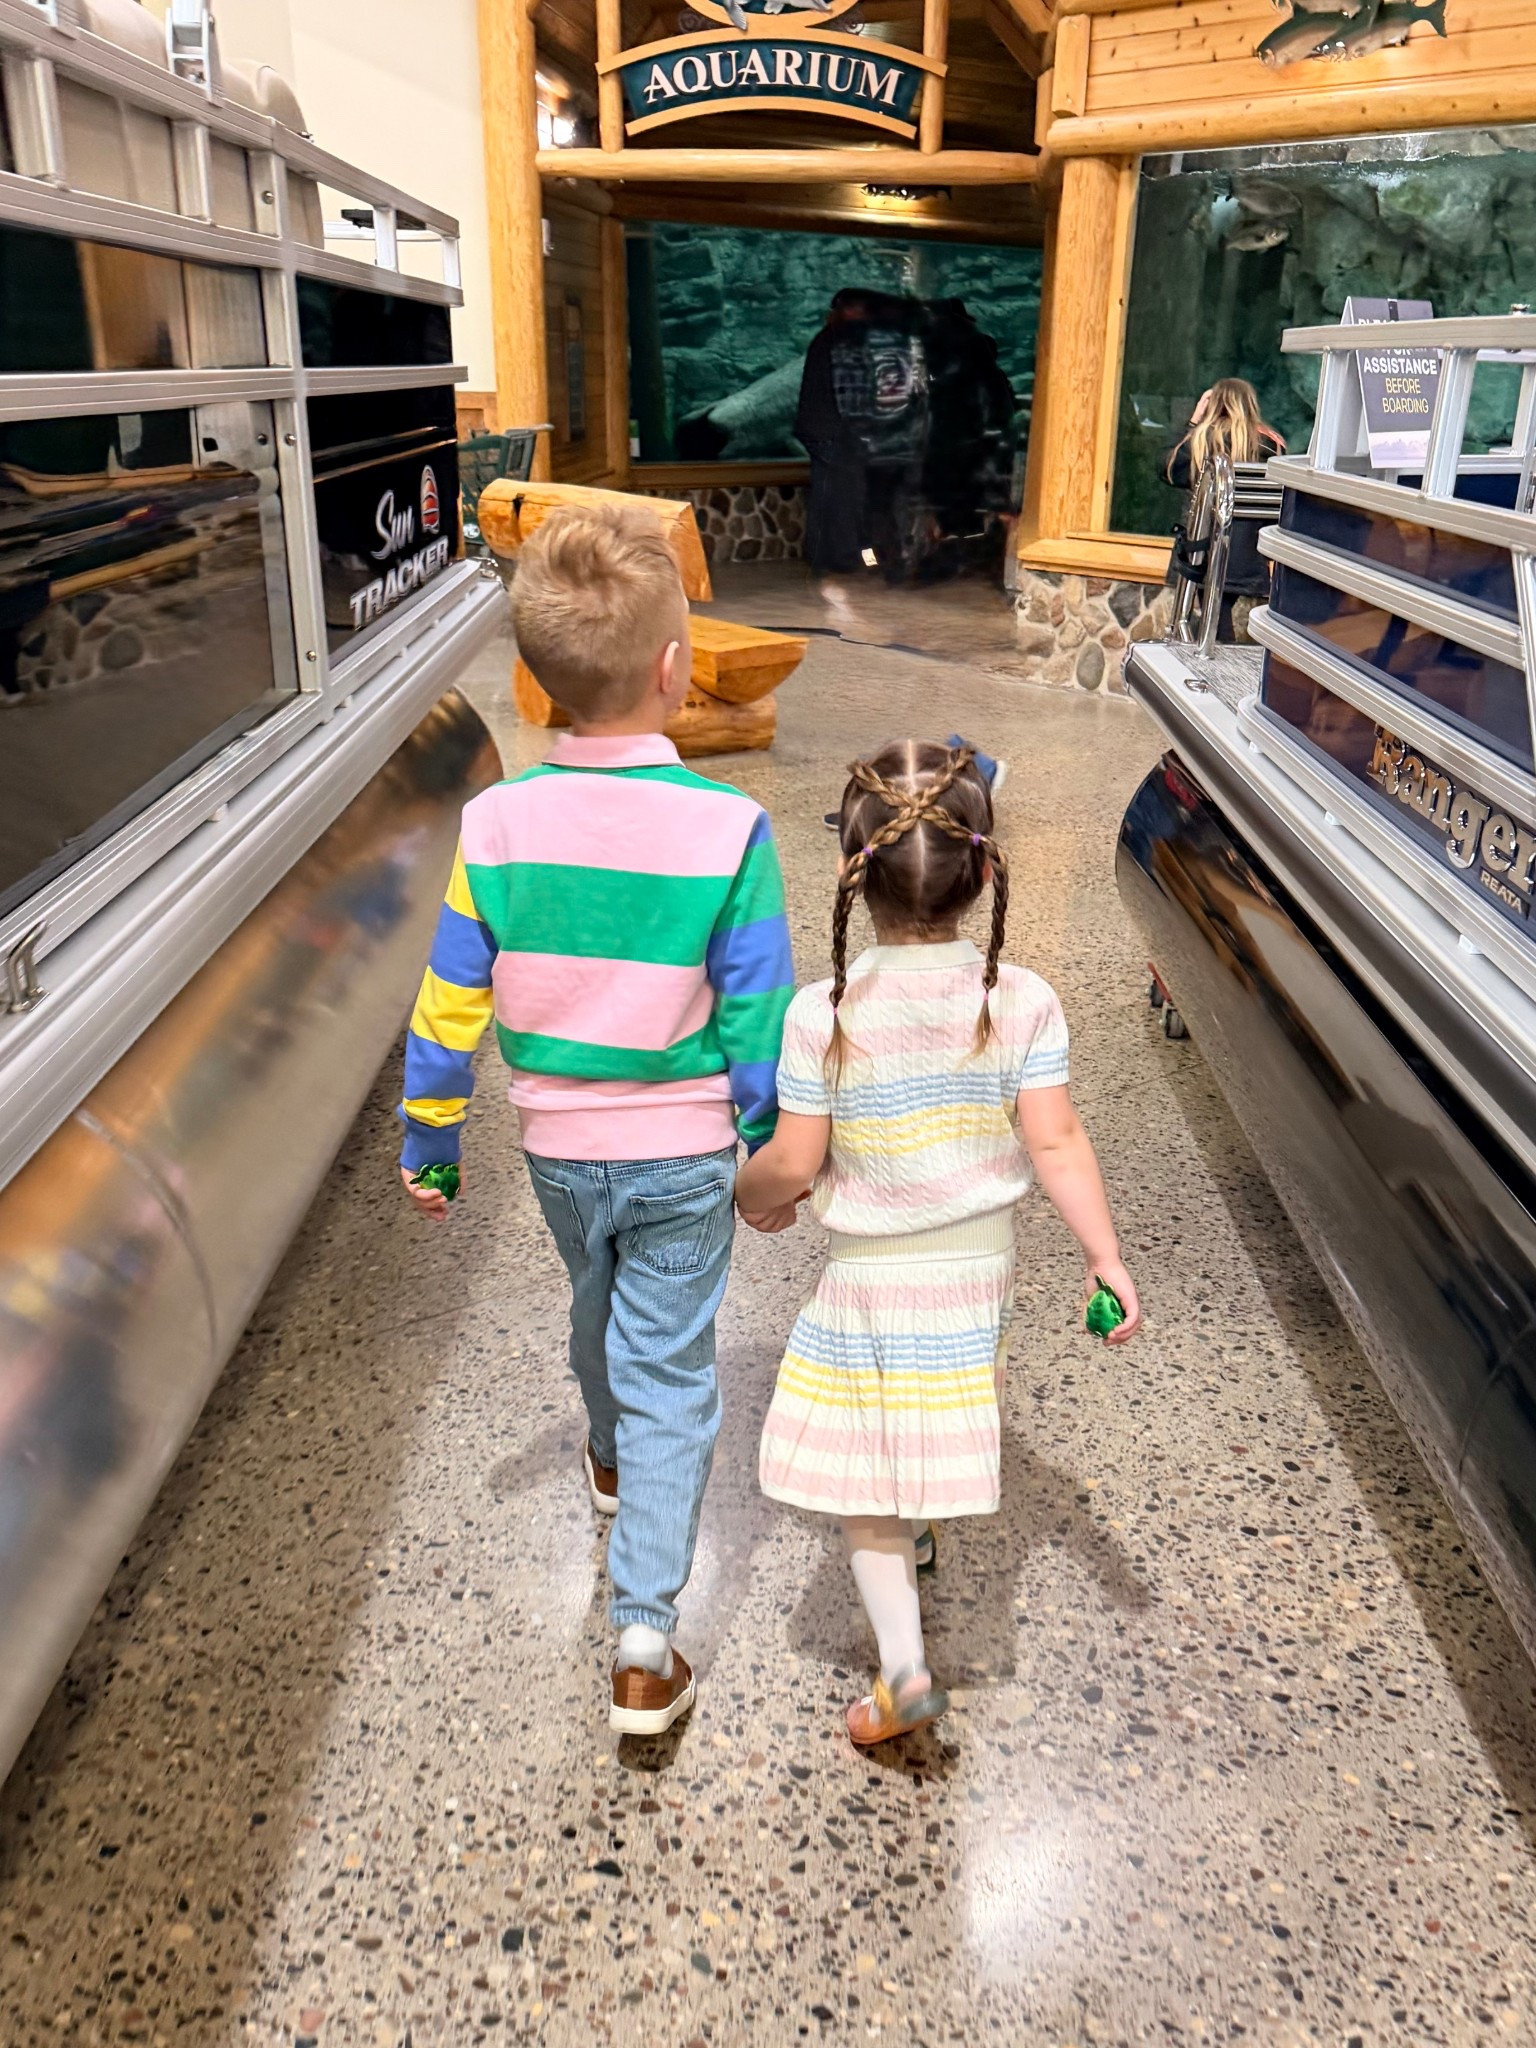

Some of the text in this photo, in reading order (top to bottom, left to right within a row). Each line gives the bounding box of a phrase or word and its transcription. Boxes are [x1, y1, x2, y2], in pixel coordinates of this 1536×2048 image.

[643, 48, 905, 107] AQUARIUM
[1363, 357, 1438, 375] ASSISTANCE
[1385, 377, 1422, 394] BEFORE
[1382, 397, 1429, 414] BOARDING
[370, 489, 415, 560] Sun
[350, 535, 450, 632] TRACKER
[1366, 722, 1536, 896] Ranger
[1479, 870, 1524, 915] REATA
